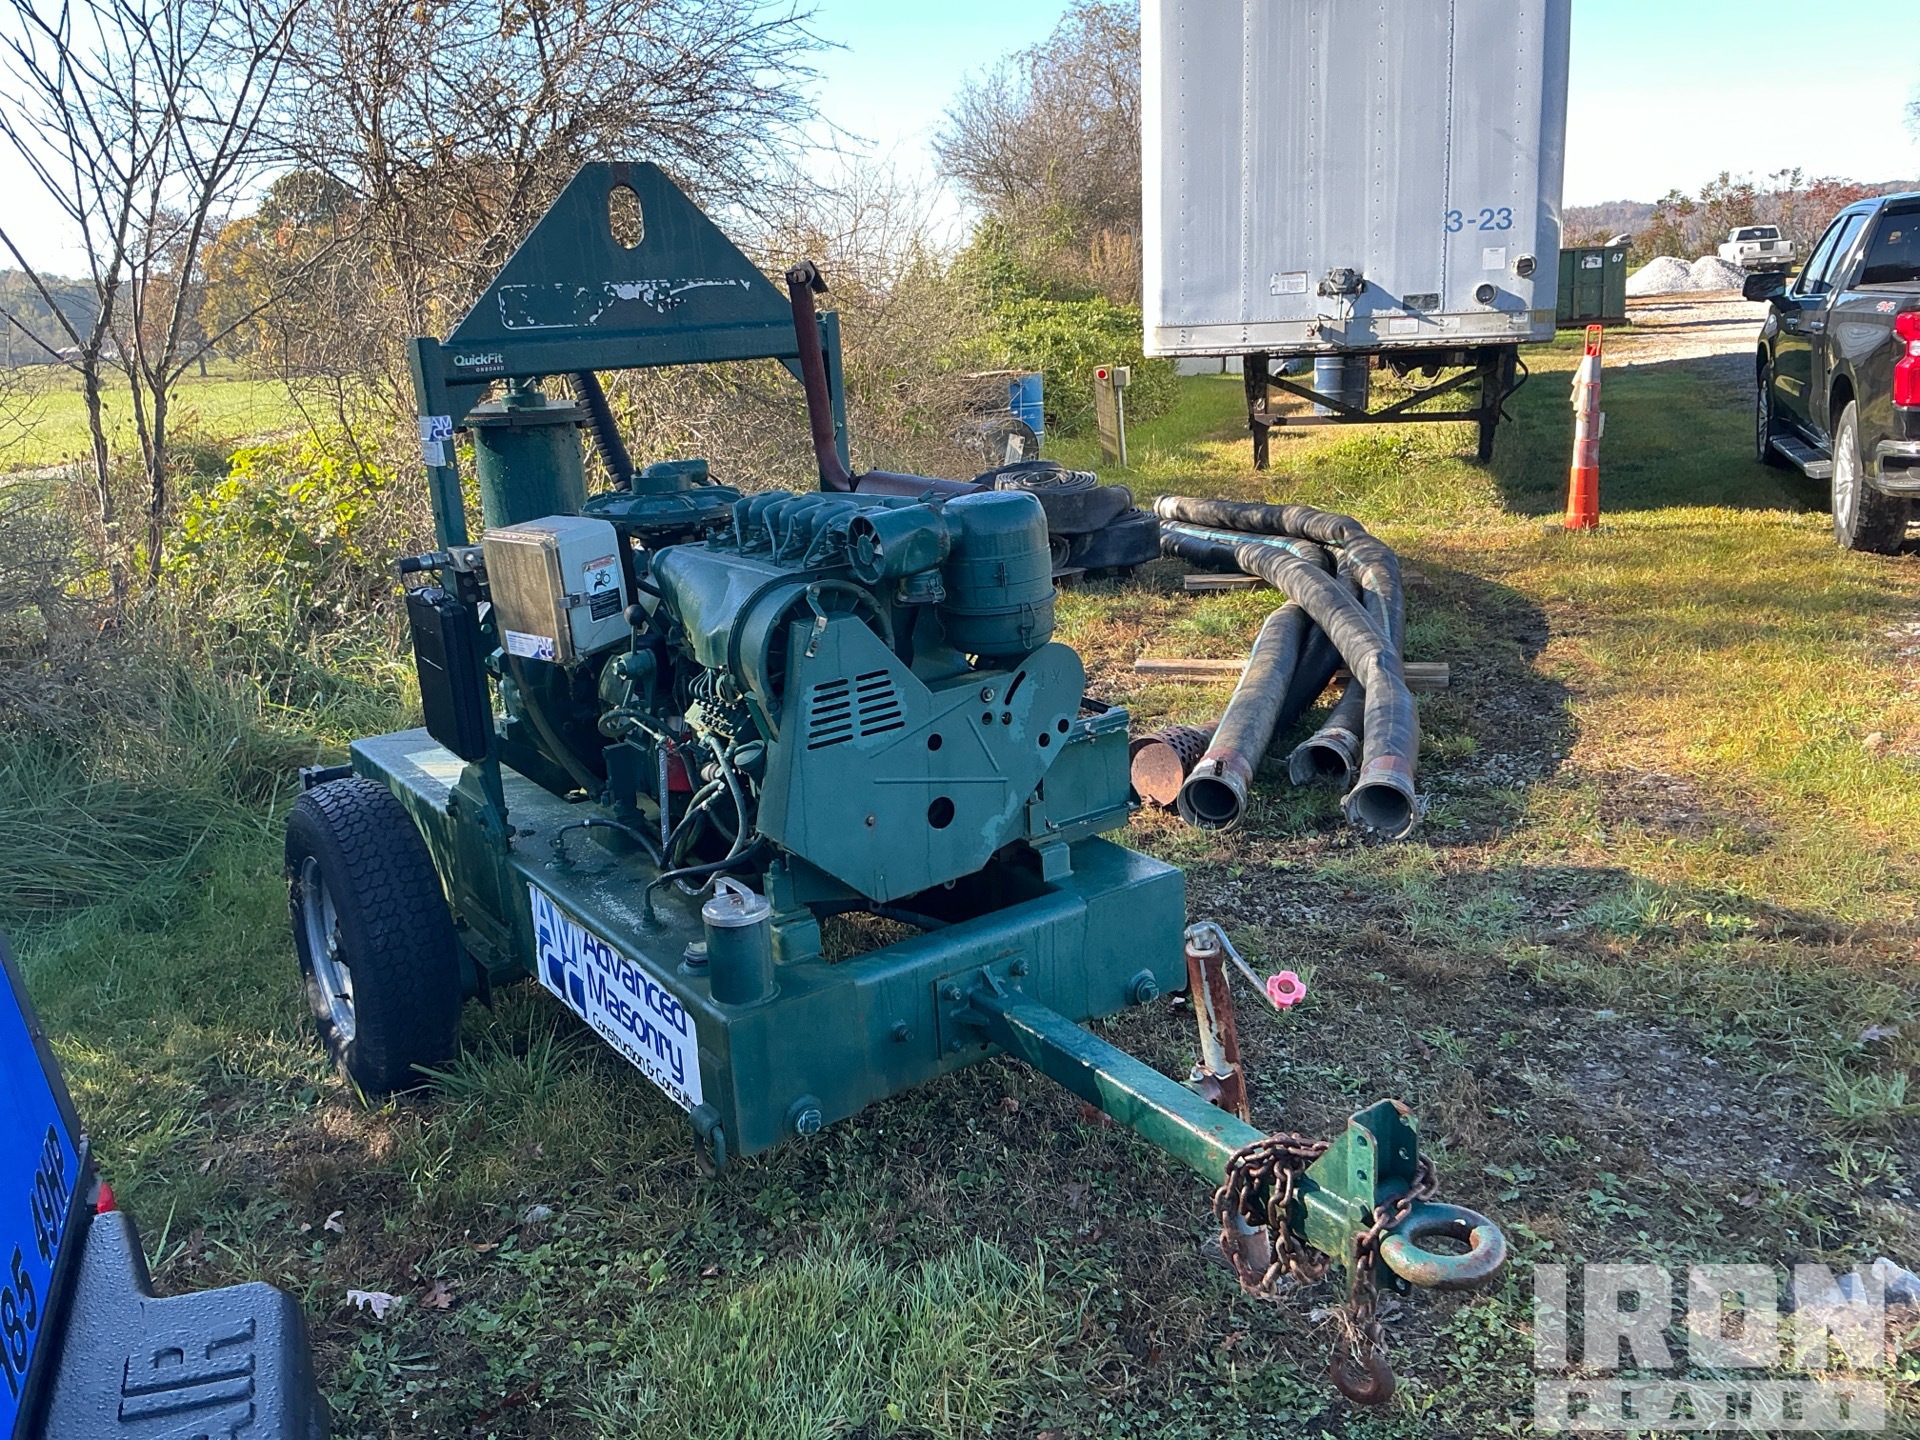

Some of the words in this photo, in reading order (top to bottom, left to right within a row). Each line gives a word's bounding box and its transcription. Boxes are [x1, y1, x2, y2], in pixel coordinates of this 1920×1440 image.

[1445, 207, 1513, 232] 3-23
[1612, 253, 1624, 263] 67
[453, 353, 503, 367] QuickFit
[586, 964, 685, 1086] Masonry
[592, 1011, 646, 1071] Construction
[646, 1058, 655, 1077] &
[0, 1241, 37, 1400] 185
